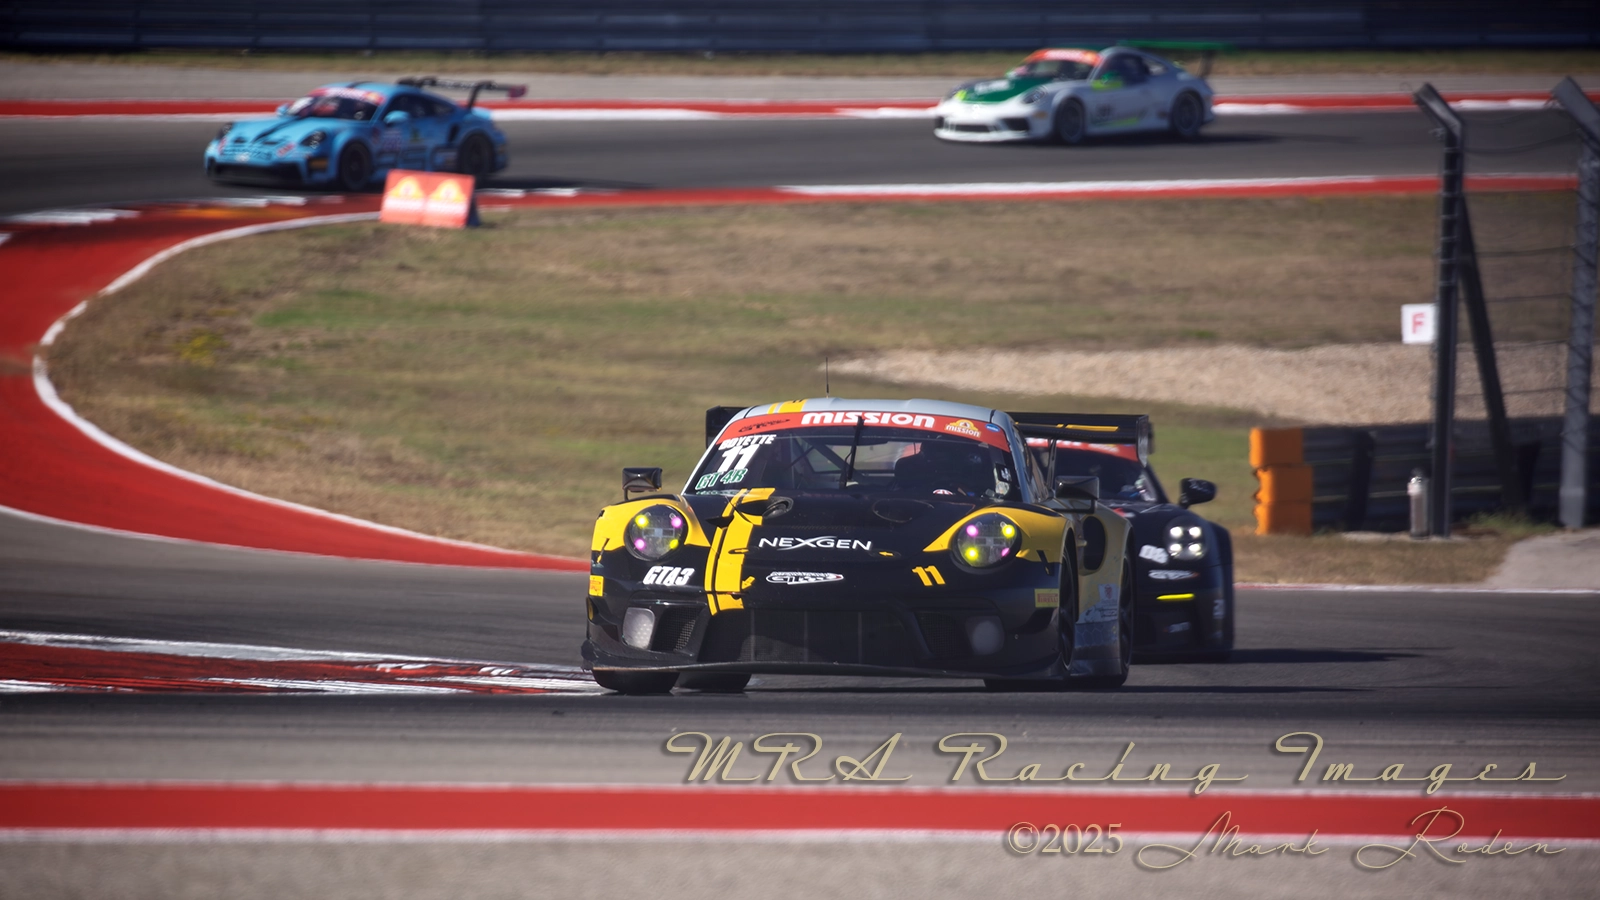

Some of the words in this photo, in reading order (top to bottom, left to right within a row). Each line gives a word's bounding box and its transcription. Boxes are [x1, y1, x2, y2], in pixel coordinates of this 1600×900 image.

[1412, 312, 1425, 335] F
[717, 443, 760, 475] 11
[758, 535, 872, 551] NEXGEN
[642, 565, 696, 587] GTA3
[911, 565, 946, 587] 11
